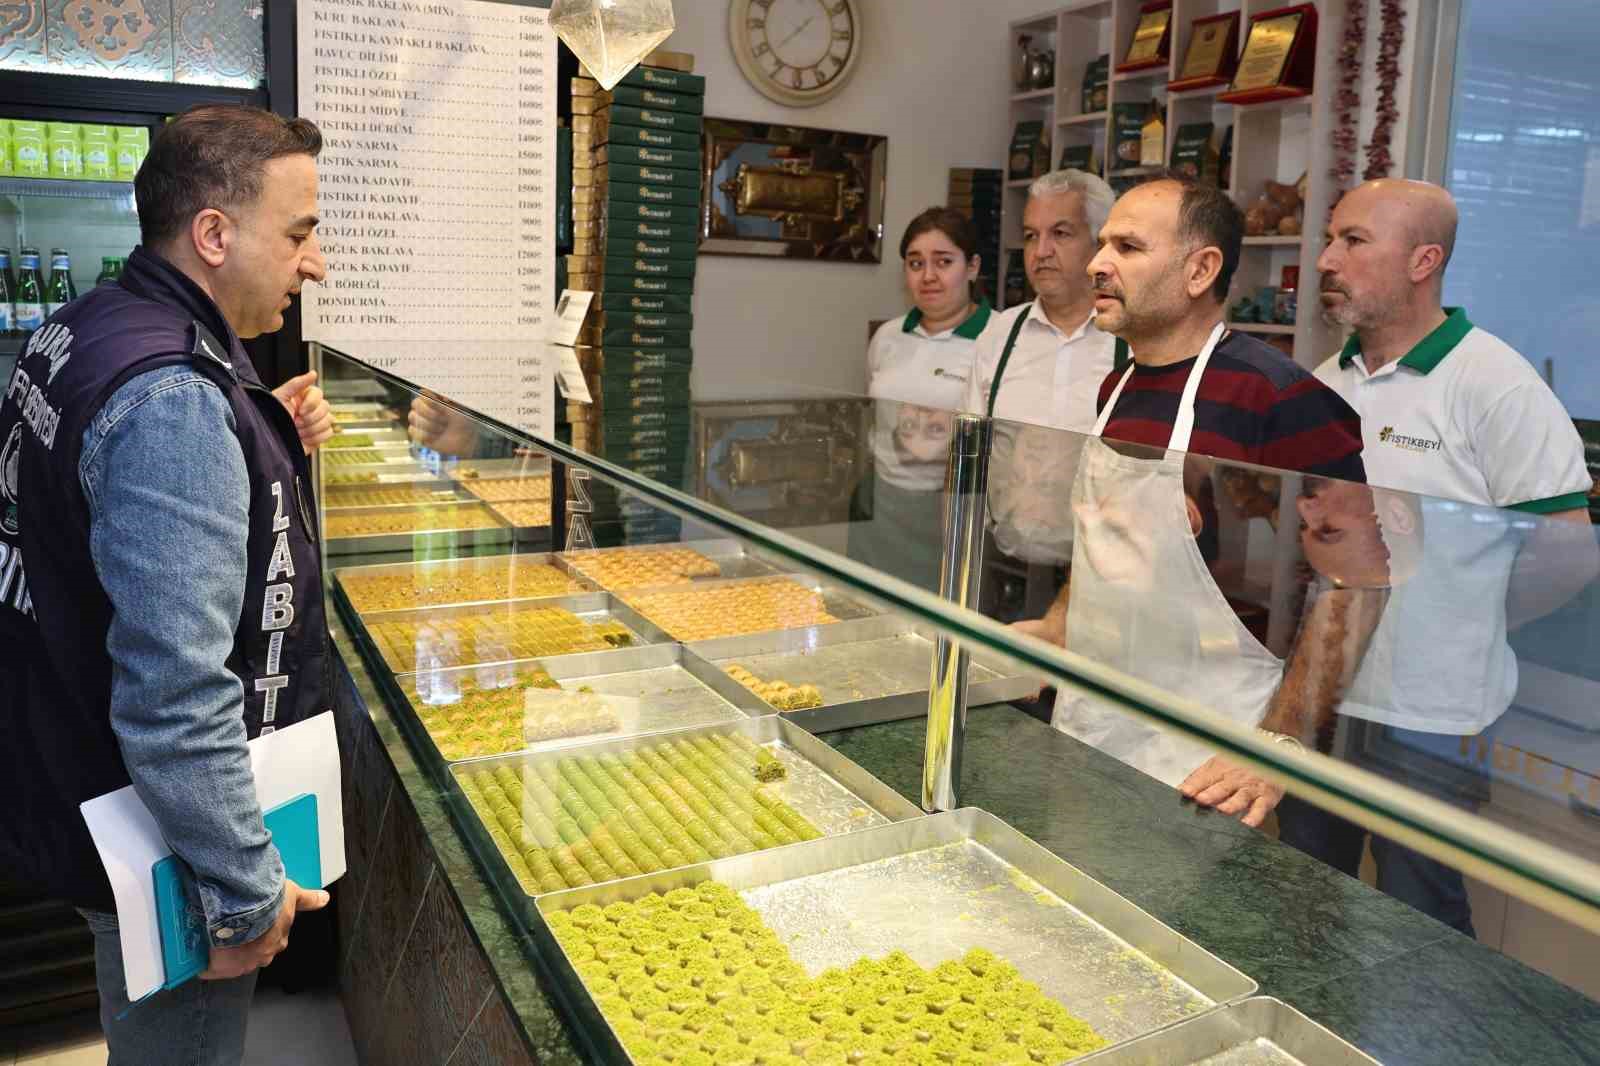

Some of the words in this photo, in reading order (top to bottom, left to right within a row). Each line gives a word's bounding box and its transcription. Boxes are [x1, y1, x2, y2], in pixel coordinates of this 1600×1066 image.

[351, 15, 406, 30] BAKLAVA
[314, 29, 366, 43] FISTIKLI
[435, 41, 487, 54] BAKLAVA
[314, 65, 366, 79] FISTIKLI
[314, 83, 366, 97] FISTIKLI
[314, 101, 367, 115] FISTIKLI
[355, 140, 399, 152] SARMA
[355, 158, 399, 169] SARMA
[367, 209, 421, 222] BAKLAVA
[361, 245, 414, 257] BAKLAVA
[317, 296, 386, 307] DONDURMA
[359, 314, 398, 325] FISTIK
